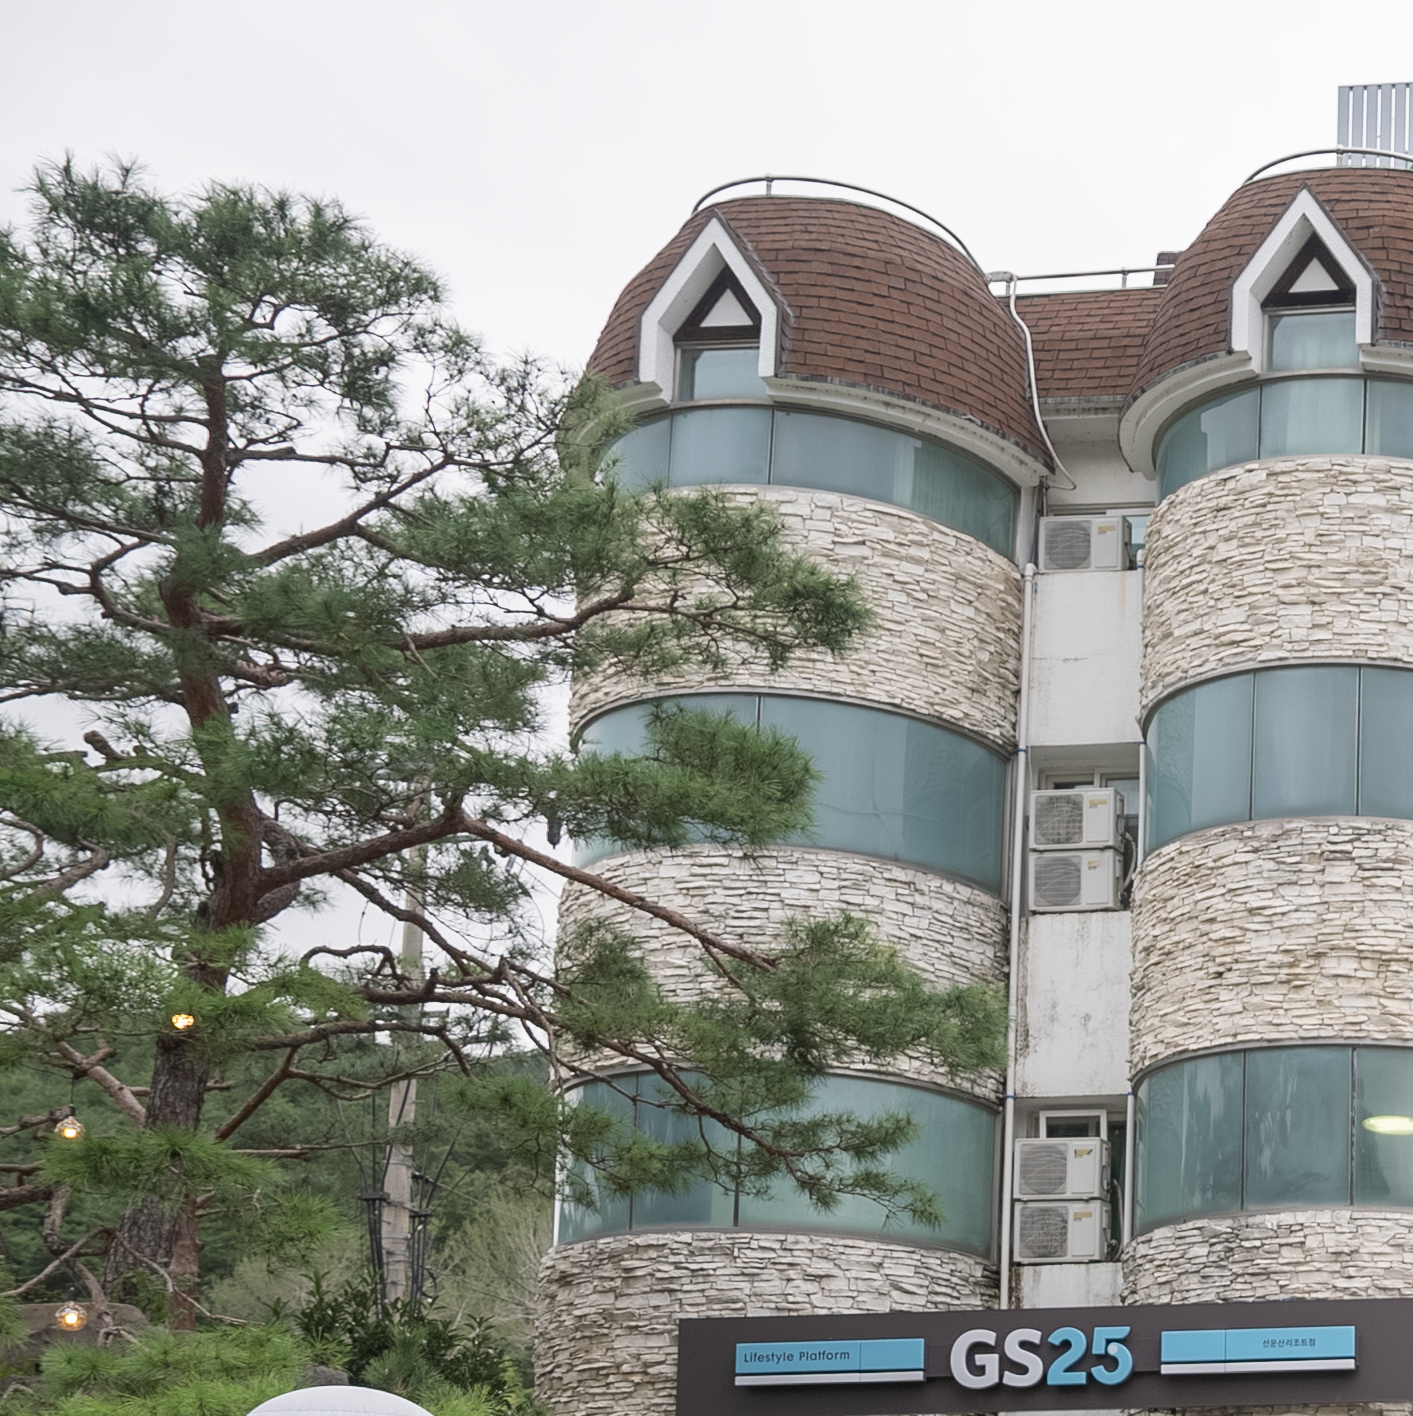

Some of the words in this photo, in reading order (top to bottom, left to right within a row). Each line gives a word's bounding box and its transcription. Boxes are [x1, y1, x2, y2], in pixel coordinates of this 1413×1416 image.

[743, 1351, 795, 1365] Lifestyle
[798, 1349, 851, 1362] Platform
[949, 1325, 1134, 1390] GS25
